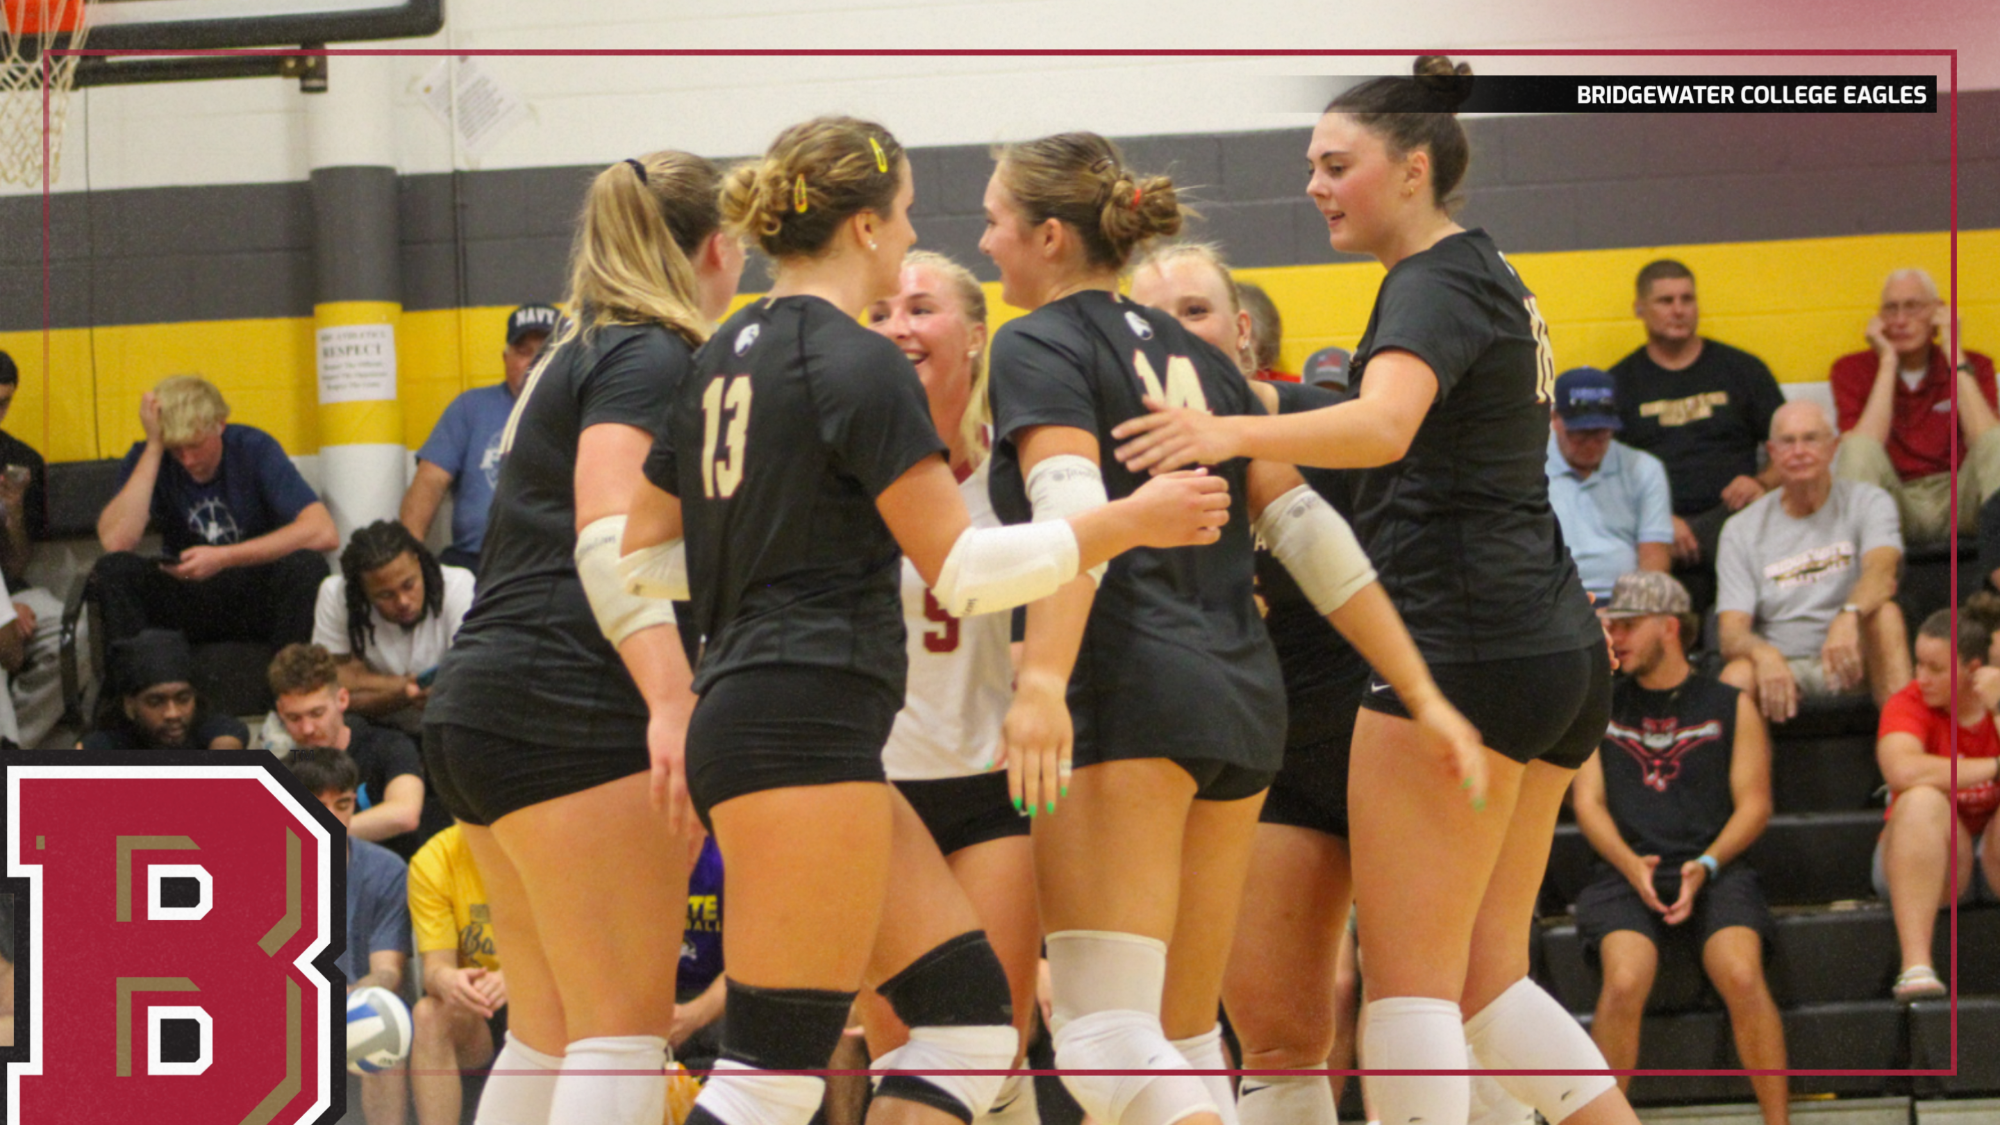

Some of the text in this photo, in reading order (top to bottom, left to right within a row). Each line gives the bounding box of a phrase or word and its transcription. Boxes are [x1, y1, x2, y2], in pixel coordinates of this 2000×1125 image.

[516, 307, 555, 327] NAVY
[323, 343, 381, 358] RESPECT
[702, 374, 753, 499] 13
